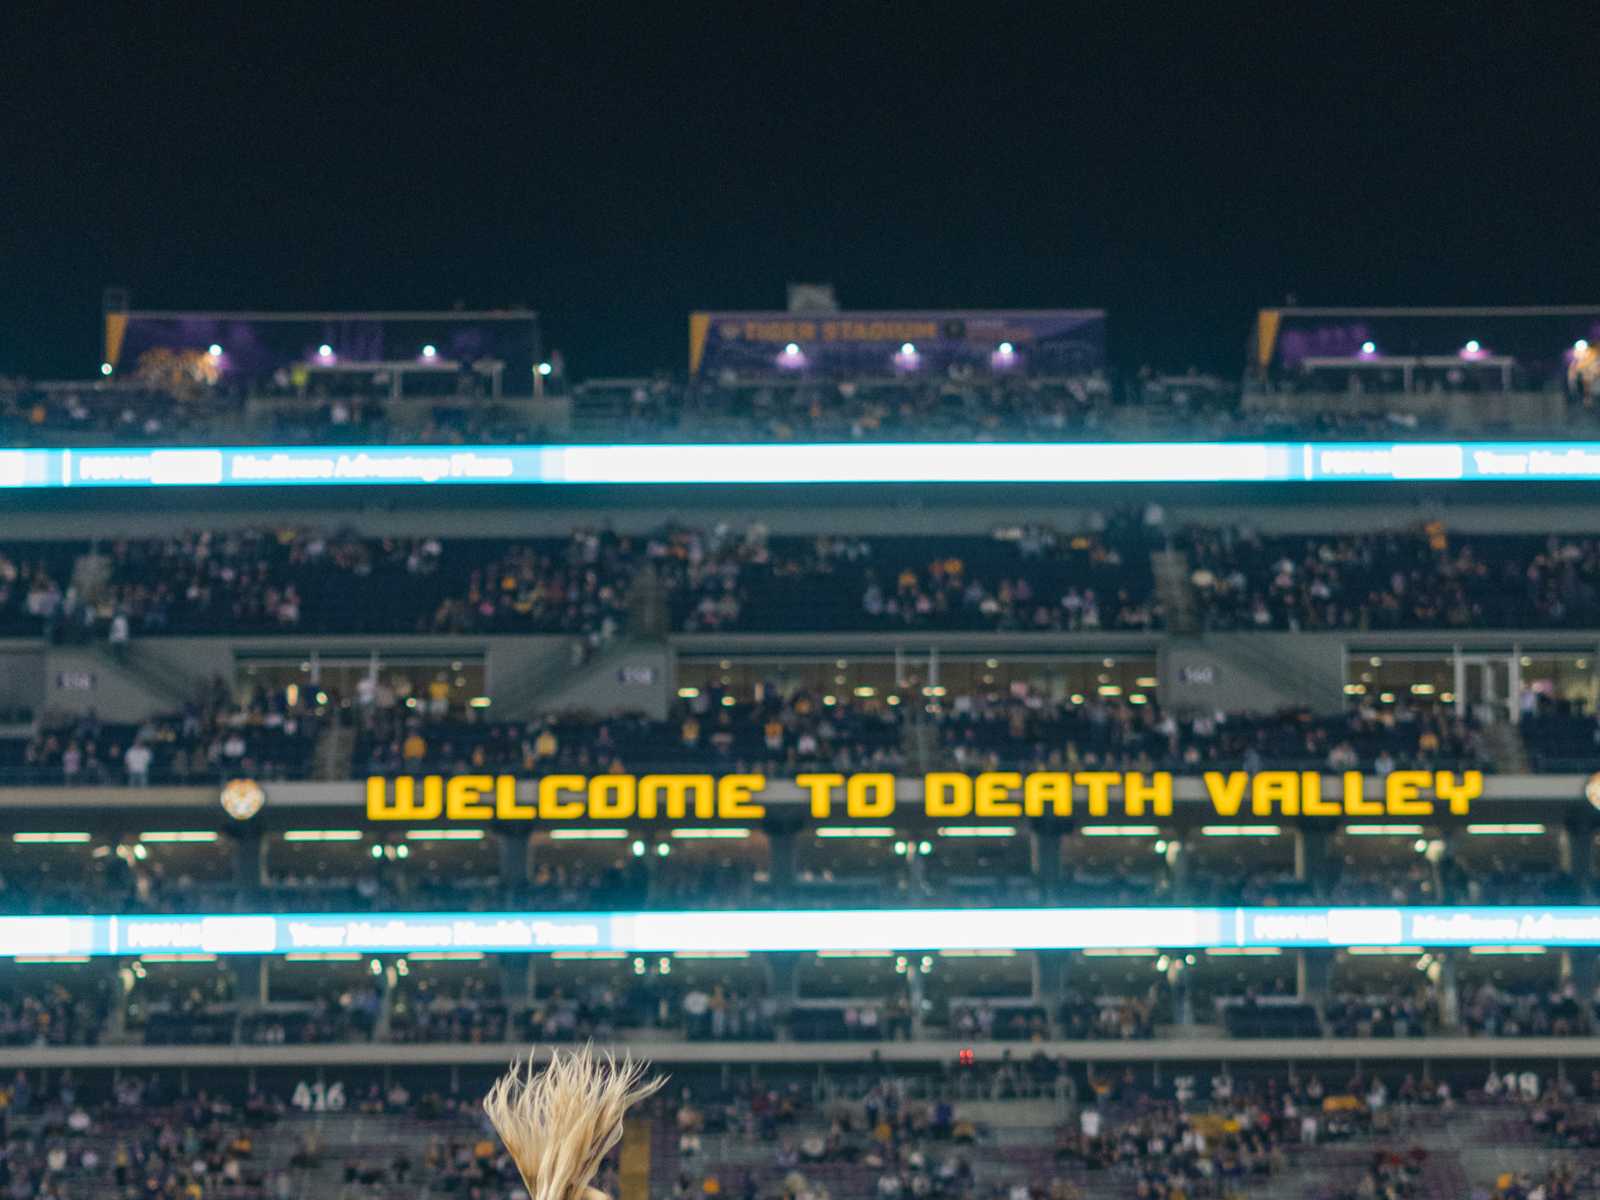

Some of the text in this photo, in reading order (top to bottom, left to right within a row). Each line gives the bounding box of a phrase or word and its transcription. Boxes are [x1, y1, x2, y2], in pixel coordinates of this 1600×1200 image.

[365, 771, 1483, 821] WELCOME TO DEATH VALLEY
[292, 1081, 346, 1112] 416
